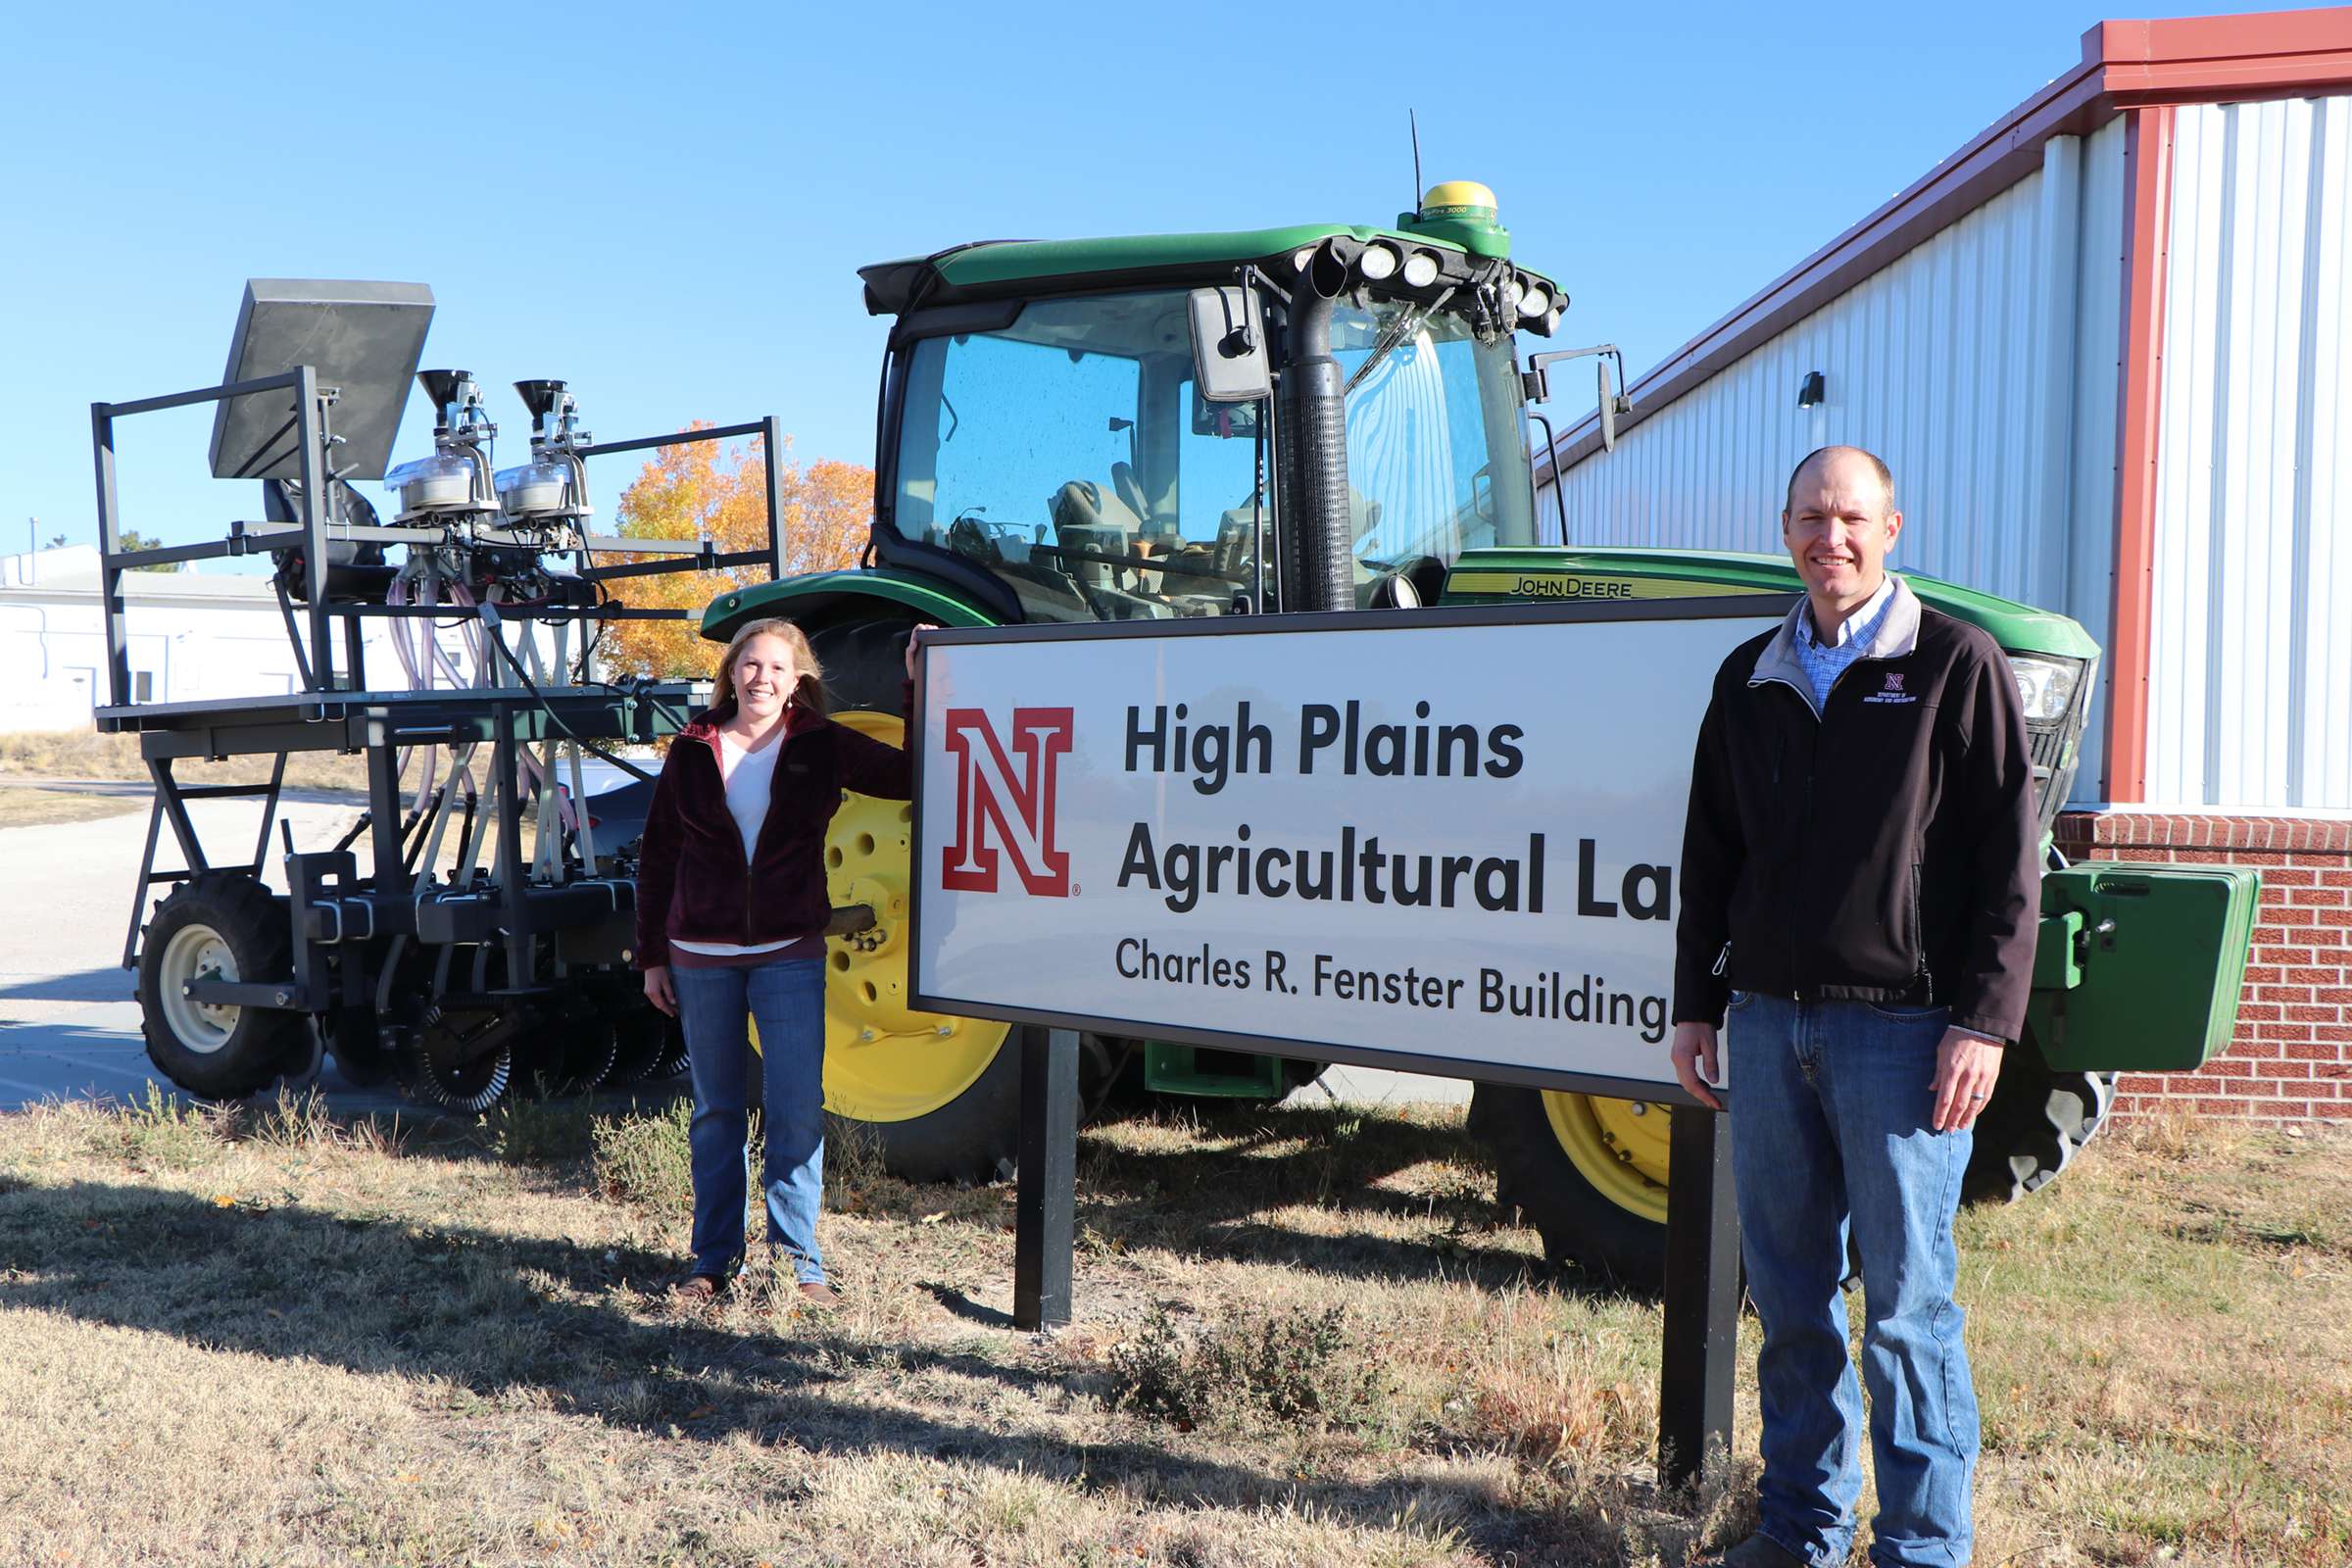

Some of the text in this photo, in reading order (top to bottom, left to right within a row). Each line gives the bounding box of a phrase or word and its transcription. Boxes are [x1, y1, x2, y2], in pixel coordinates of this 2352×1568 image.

[1446, 205, 1468, 215] 3000
[1510, 576, 1633, 597] JOHN DEERE
[1884, 672, 1904, 690] N
[1125, 700, 1524, 796] High Plains
[942, 707, 1074, 898] N
[1116, 822, 1672, 921] Agricultural La
[1115, 938, 1667, 1045] Charles R. Fenster Building
